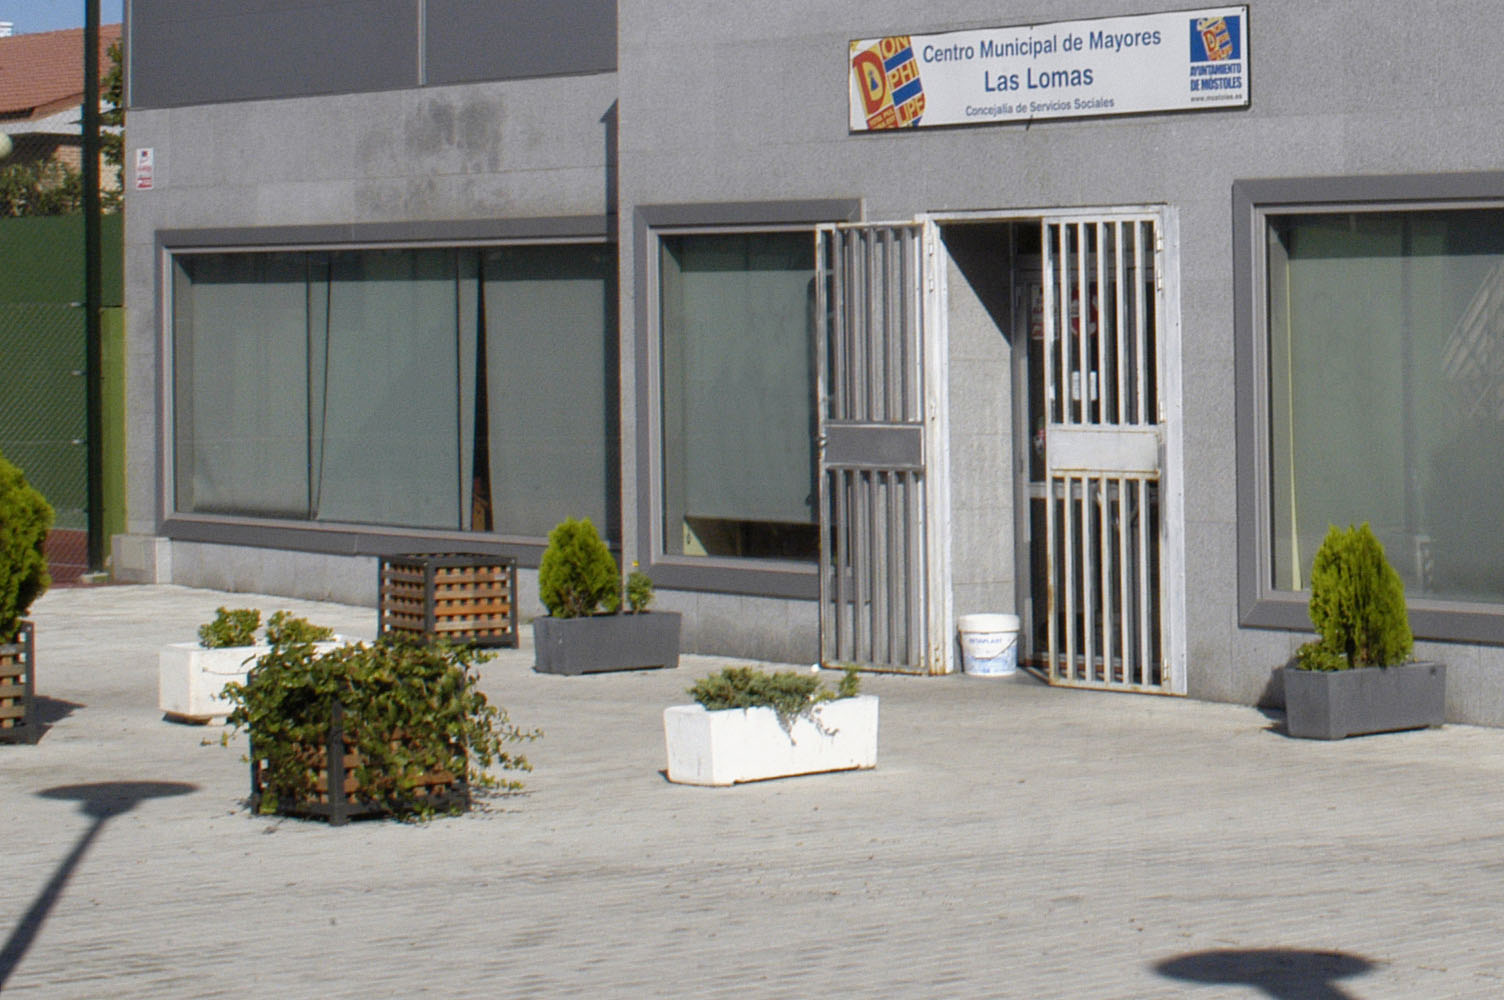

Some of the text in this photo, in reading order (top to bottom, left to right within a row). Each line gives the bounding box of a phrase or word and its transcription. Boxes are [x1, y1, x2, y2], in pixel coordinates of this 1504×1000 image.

[923, 29, 1161, 63] Centro Municipal de Mayores
[985, 67, 1094, 92] Las Lomas
[1190, 63, 1241, 76] AYUNTAMIENTO
[1190, 78, 1200, 91] DE
[965, 96, 1115, 118] Concejalía de Servicios Sociales
